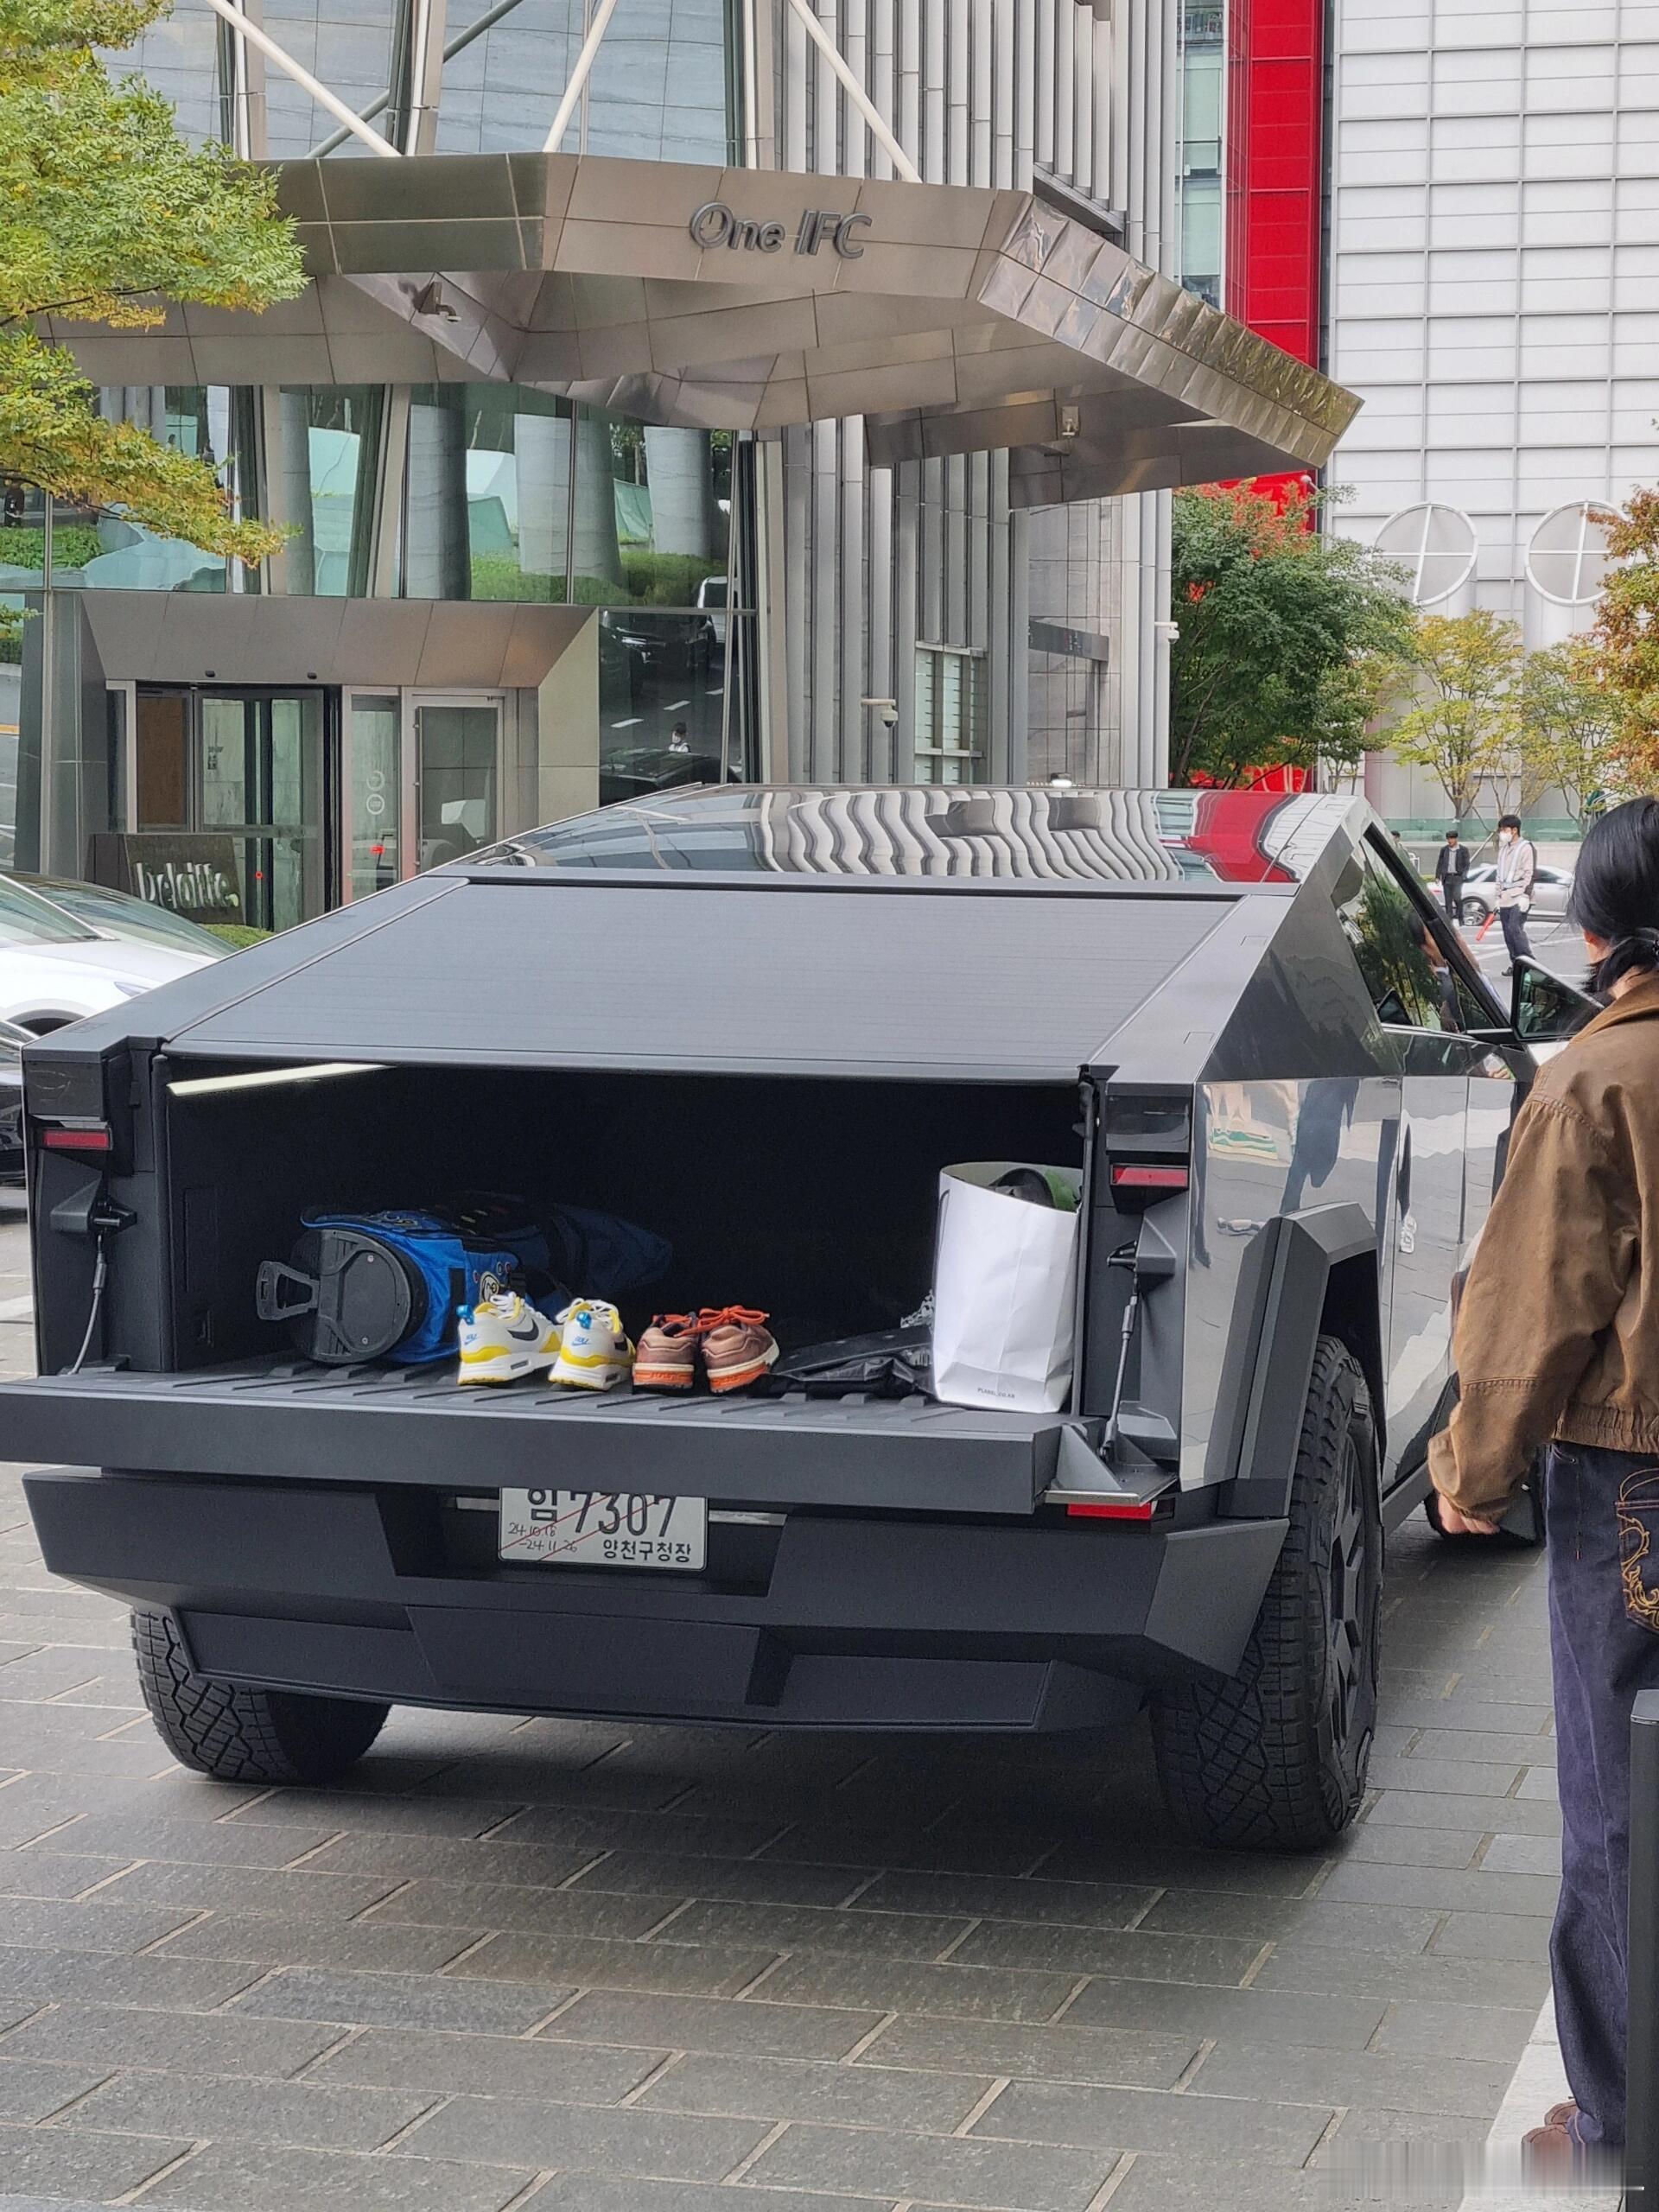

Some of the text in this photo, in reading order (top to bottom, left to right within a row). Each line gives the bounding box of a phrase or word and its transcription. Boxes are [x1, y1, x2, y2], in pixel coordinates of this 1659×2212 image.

[690, 201, 873, 259] One IFC
[569, 1491, 678, 1538] 7307
[603, 1539, 691, 1563] 양천구청장
